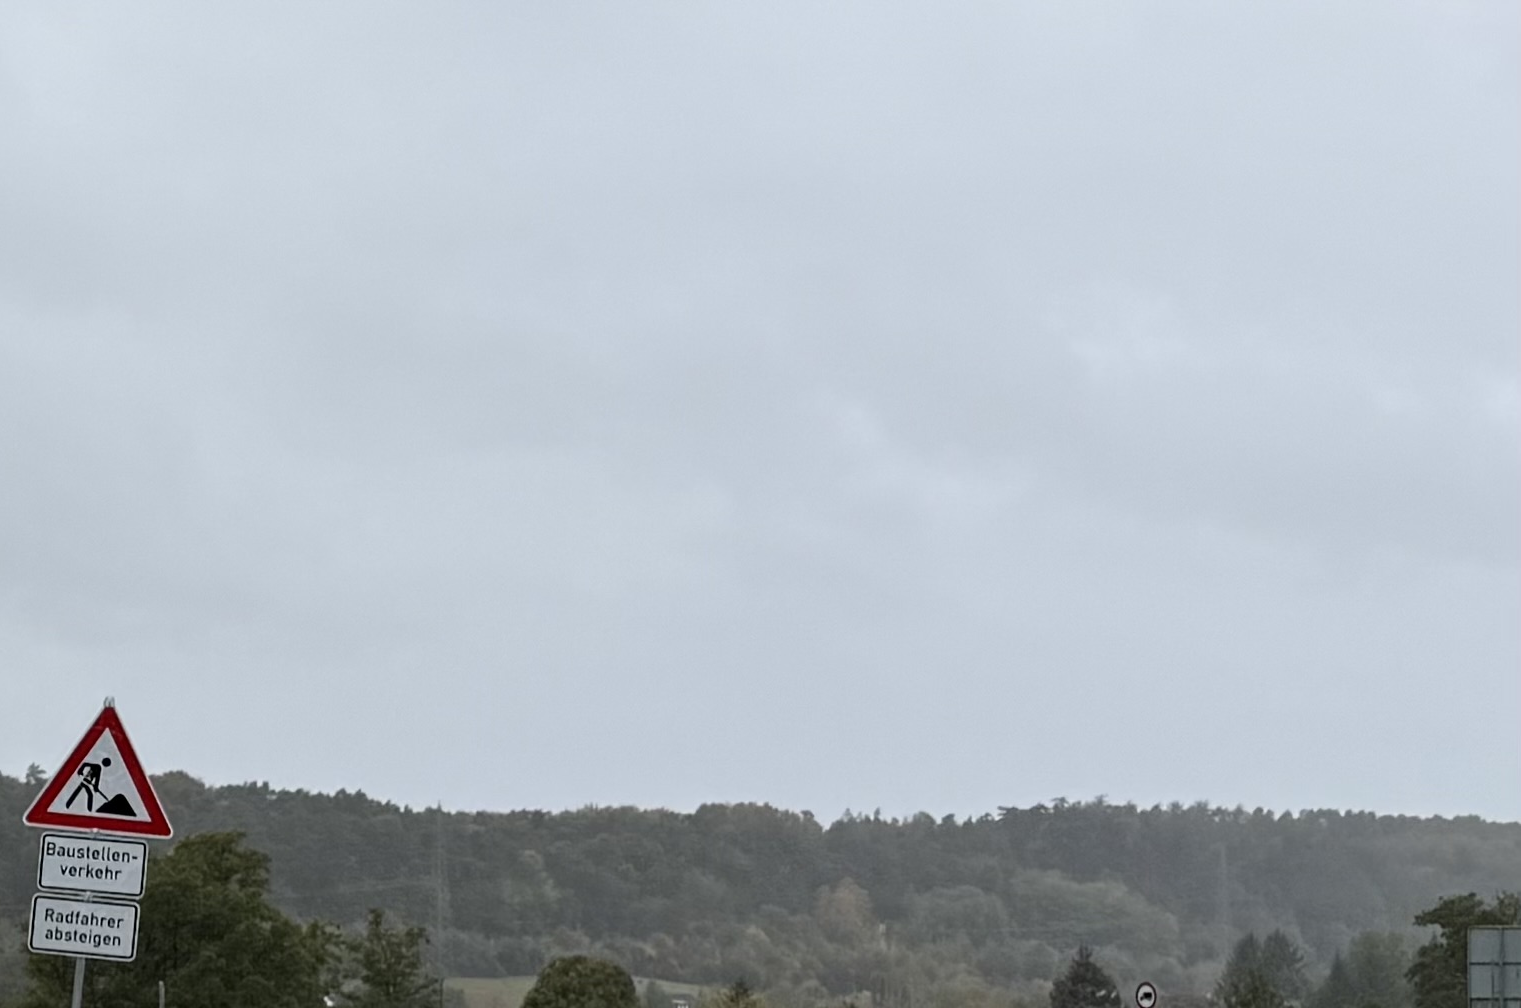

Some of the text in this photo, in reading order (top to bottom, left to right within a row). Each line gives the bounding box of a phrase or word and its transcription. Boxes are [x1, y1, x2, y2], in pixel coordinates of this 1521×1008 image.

[46, 841, 138, 863] Baustellen-
[60, 863, 122, 881] verkehr
[45, 908, 124, 929] Radfahrer
[45, 927, 121, 948] absteigen
